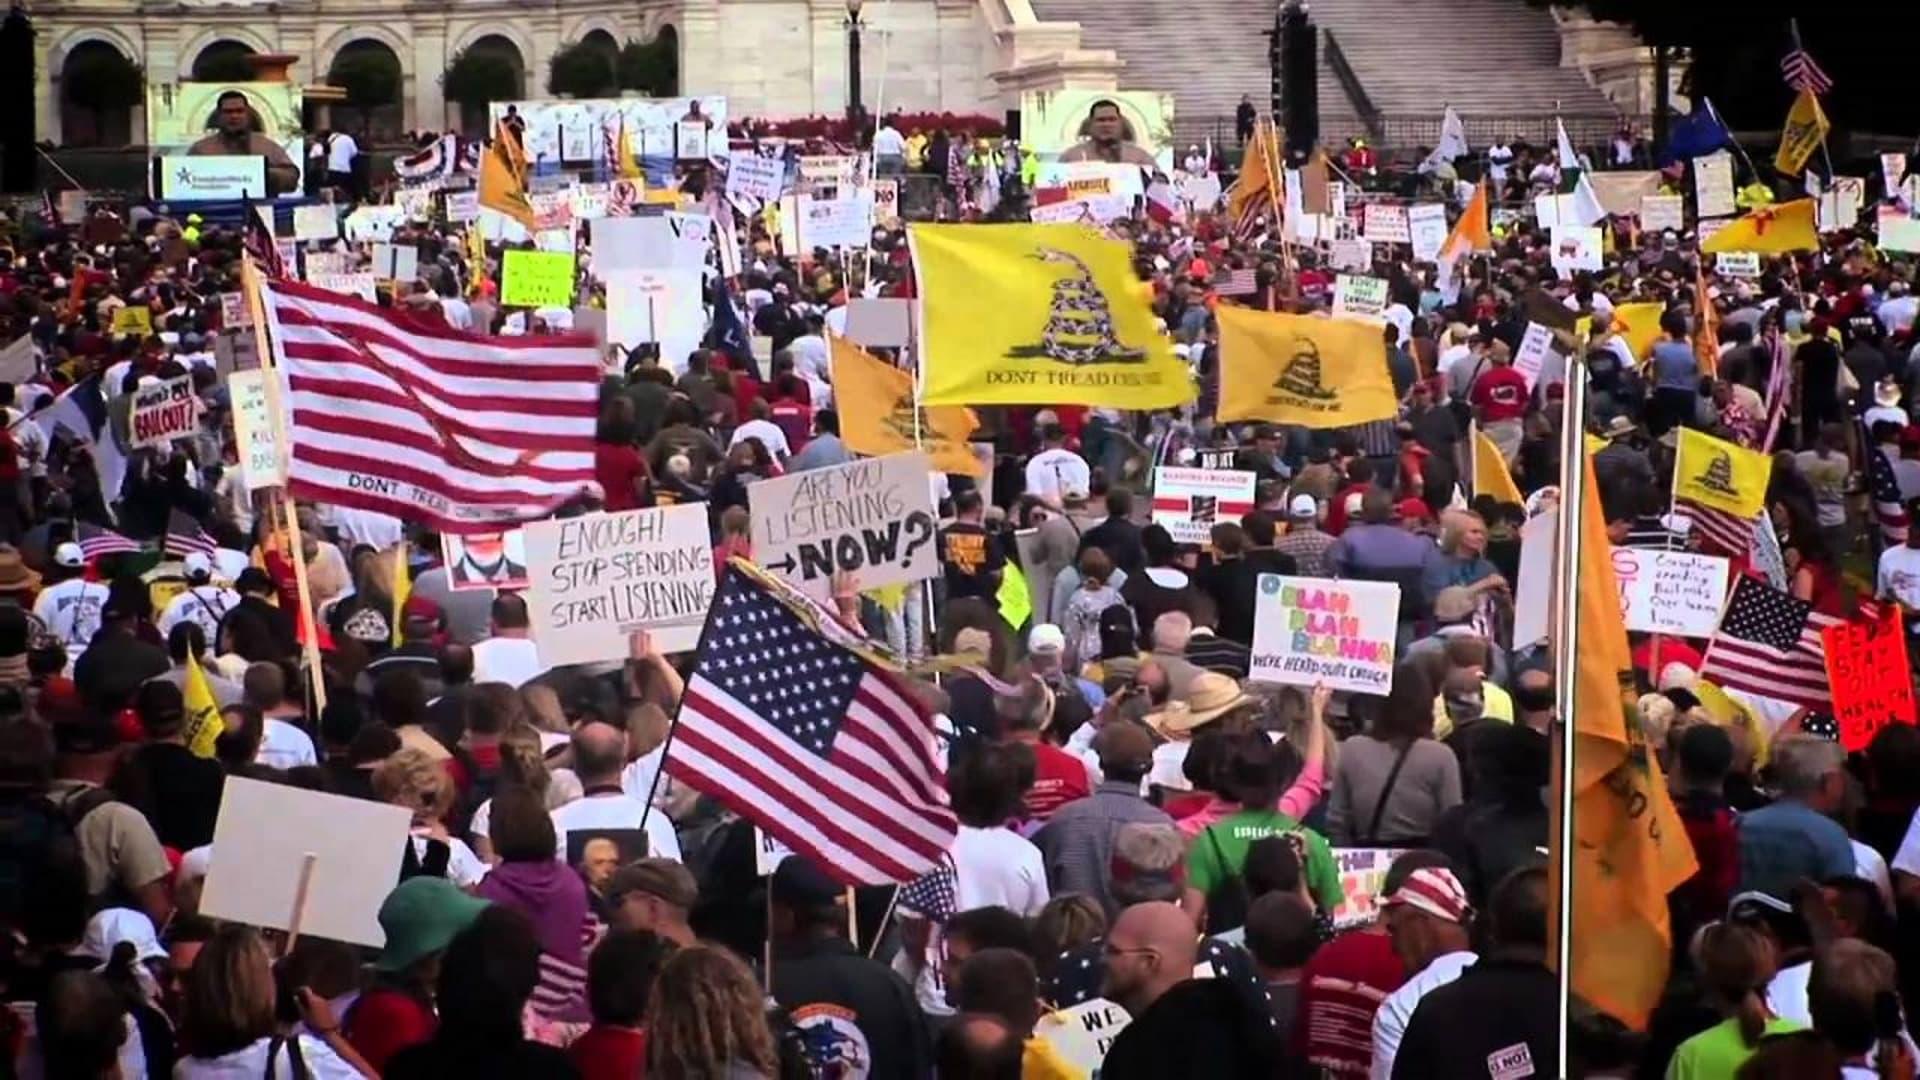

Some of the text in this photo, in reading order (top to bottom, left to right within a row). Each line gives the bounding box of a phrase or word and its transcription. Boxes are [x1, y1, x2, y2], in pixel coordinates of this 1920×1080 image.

[133, 398, 194, 441] BAILOUT?
[791, 460, 884, 508] ARE YOU
[558, 508, 665, 561] ENOUGH!
[765, 484, 906, 546] LISTENING
[550, 545, 711, 594] STOP SPENDING
[798, 509, 933, 581] NOW?
[550, 579, 714, 629] START LISTENING
